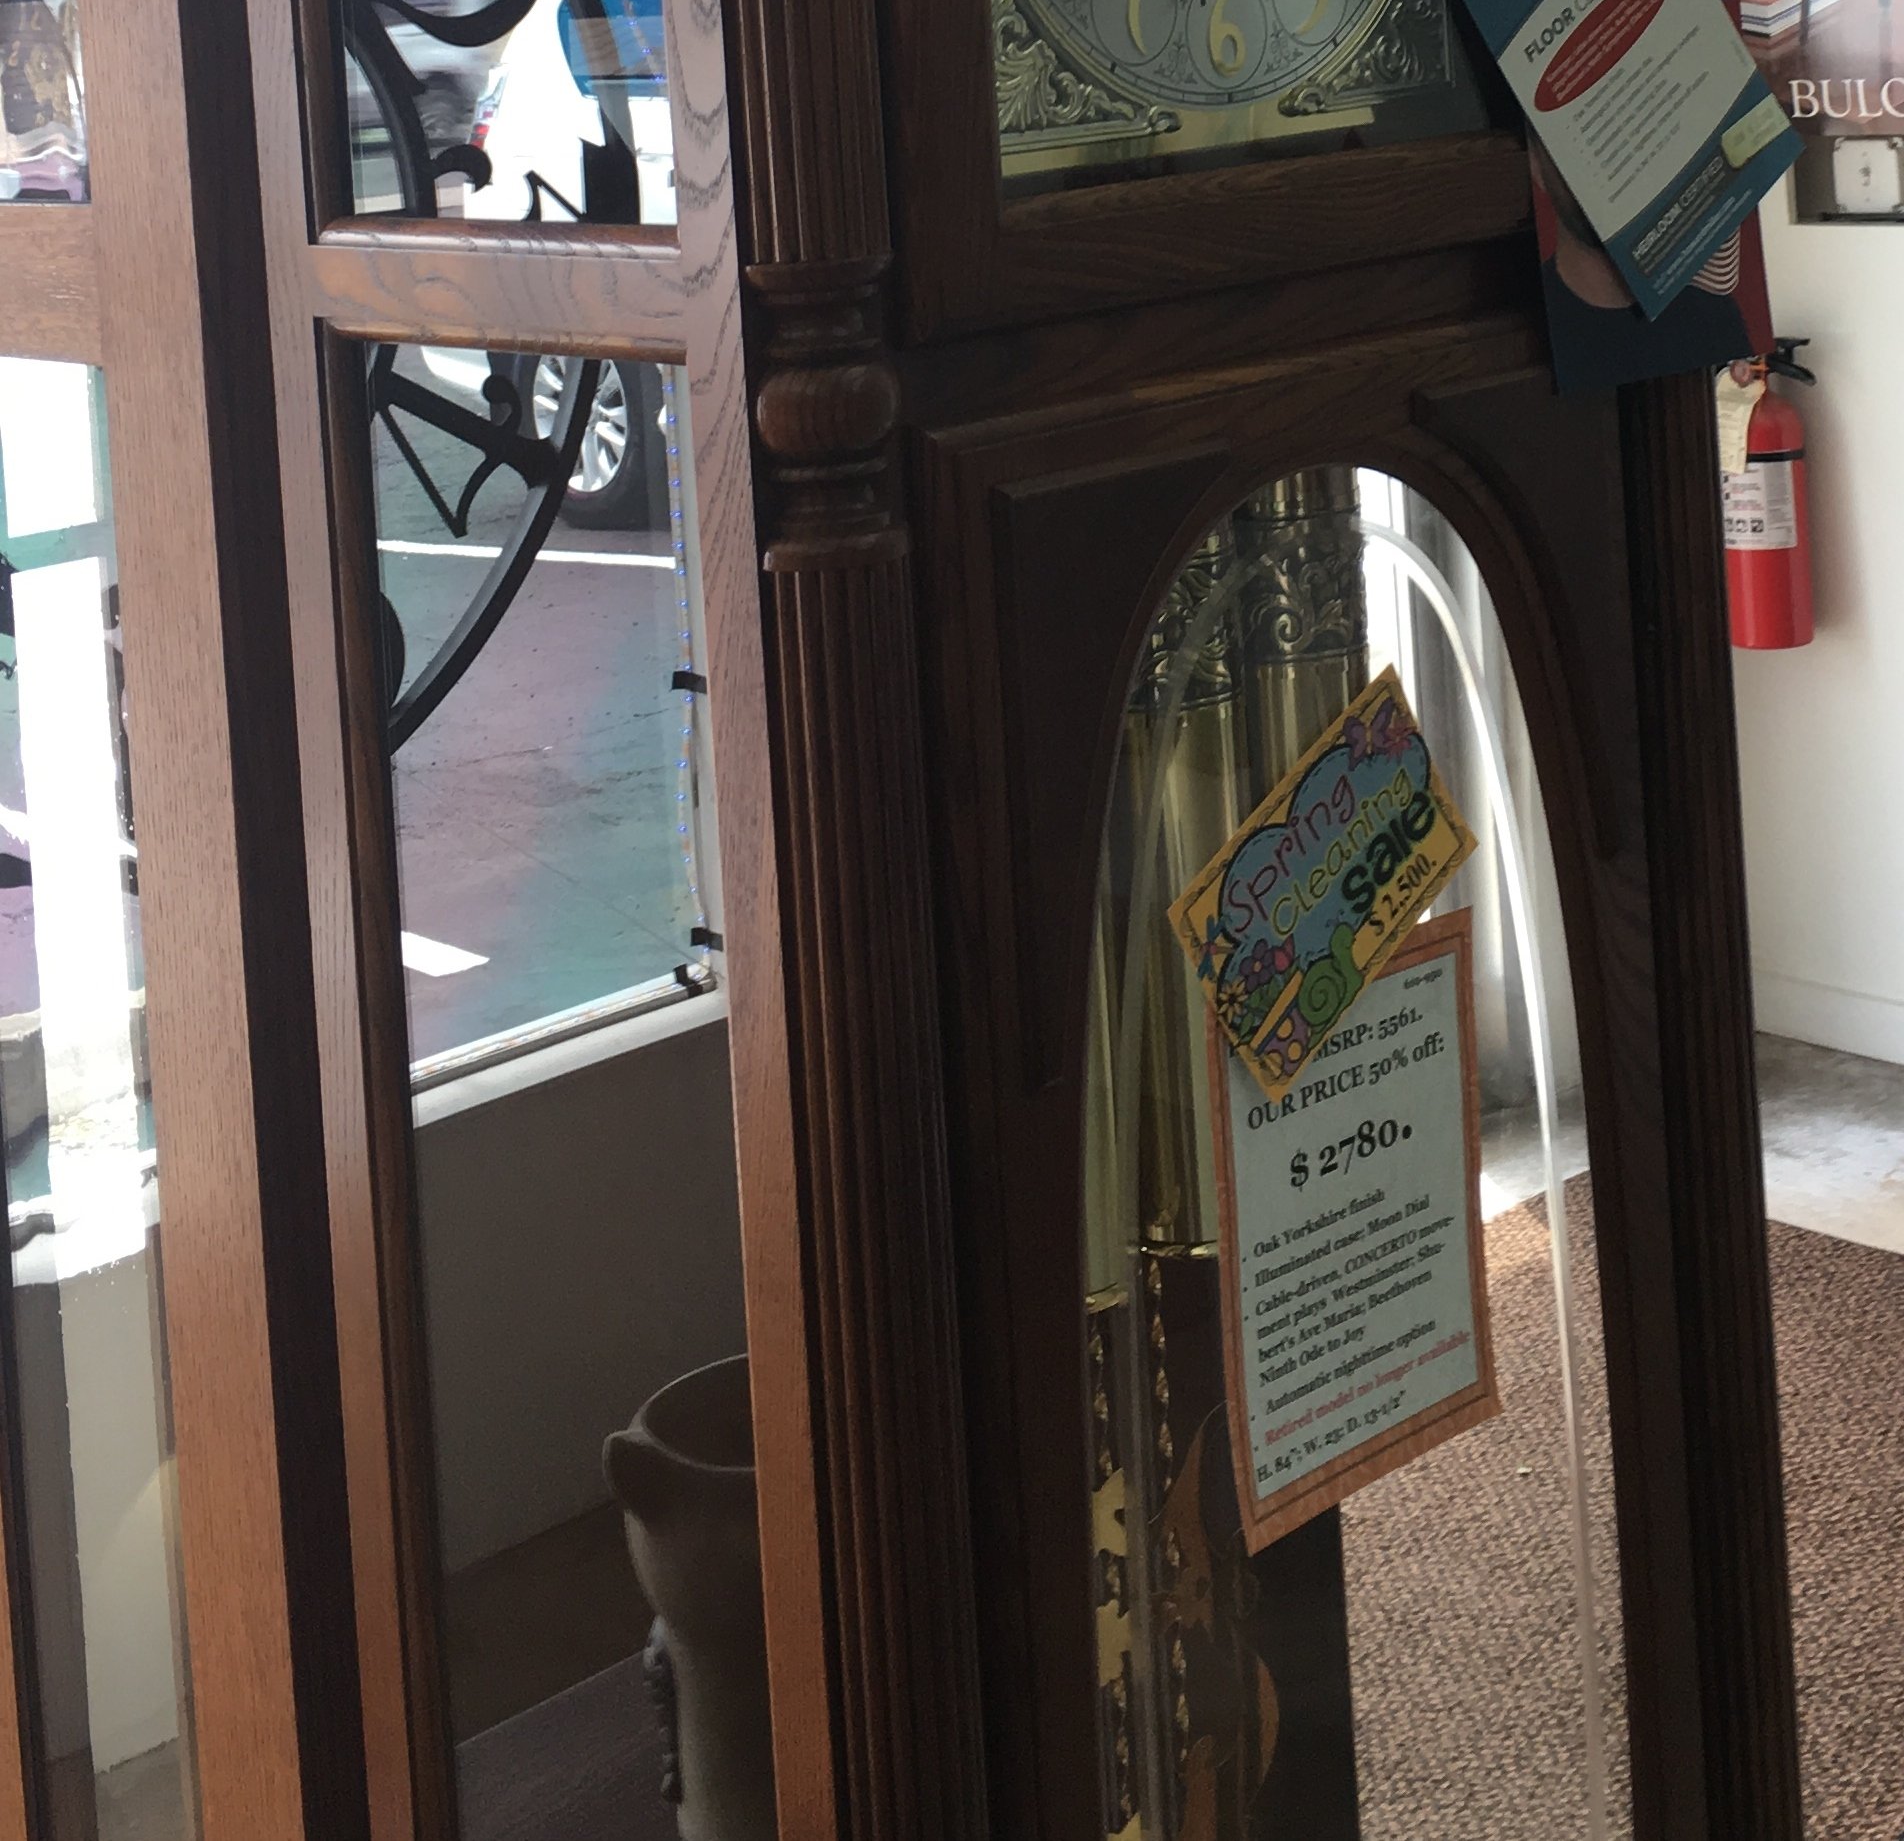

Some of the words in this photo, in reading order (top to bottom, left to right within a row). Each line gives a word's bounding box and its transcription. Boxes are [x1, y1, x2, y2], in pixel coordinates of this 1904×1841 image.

[1523, 7, 1576, 63] FLOOR
[1228, 774, 1356, 933] Spring
[1378, 1006, 1423, 1040] 5561.
[1248, 1093, 1297, 1129] OUR
[1300, 1064, 1365, 1109] PRICE
[1369, 1046, 1408, 1086] 50%
[1412, 1031, 1444, 1062] off:
[1319, 1119, 1412, 1176] 2780.
[1254, 1235, 1281, 1257] Oak
[1281, 1208, 1347, 1245] Yorkshire
[1349, 1188, 1385, 1214] finish
[1255, 1239, 1331, 1287] Illuminated
[1367, 1211, 1402, 1235] Moon
[1405, 1194, 1429, 1218] Dial
[1345, 1229, 1417, 1274] CONCERTO
[1418, 1216, 1456, 1239] move-
[1257, 1313, 1291, 1340] ment
[1293, 1298, 1327, 1326] plays
[1298, 1324, 1321, 1345] Ave
[1368, 1270, 1432, 1310] Beethoven
[1260, 1357, 1297, 1387] Ninth
[1299, 1345, 1325, 1366] Ode
[1327, 1338, 1341, 1352] to
[1342, 1326, 1366, 1345] Joy
[1266, 1370, 1331, 1415] Automatic
[1333, 1340, 1395, 1378] nighttime
[1396, 1320, 1436, 1348] option
[1315, 1386, 1354, 1419] model
[1357, 1381, 1374, 1398] no
[1375, 1360, 1414, 1388] longer
[1418, 1330, 1470, 1366] available
